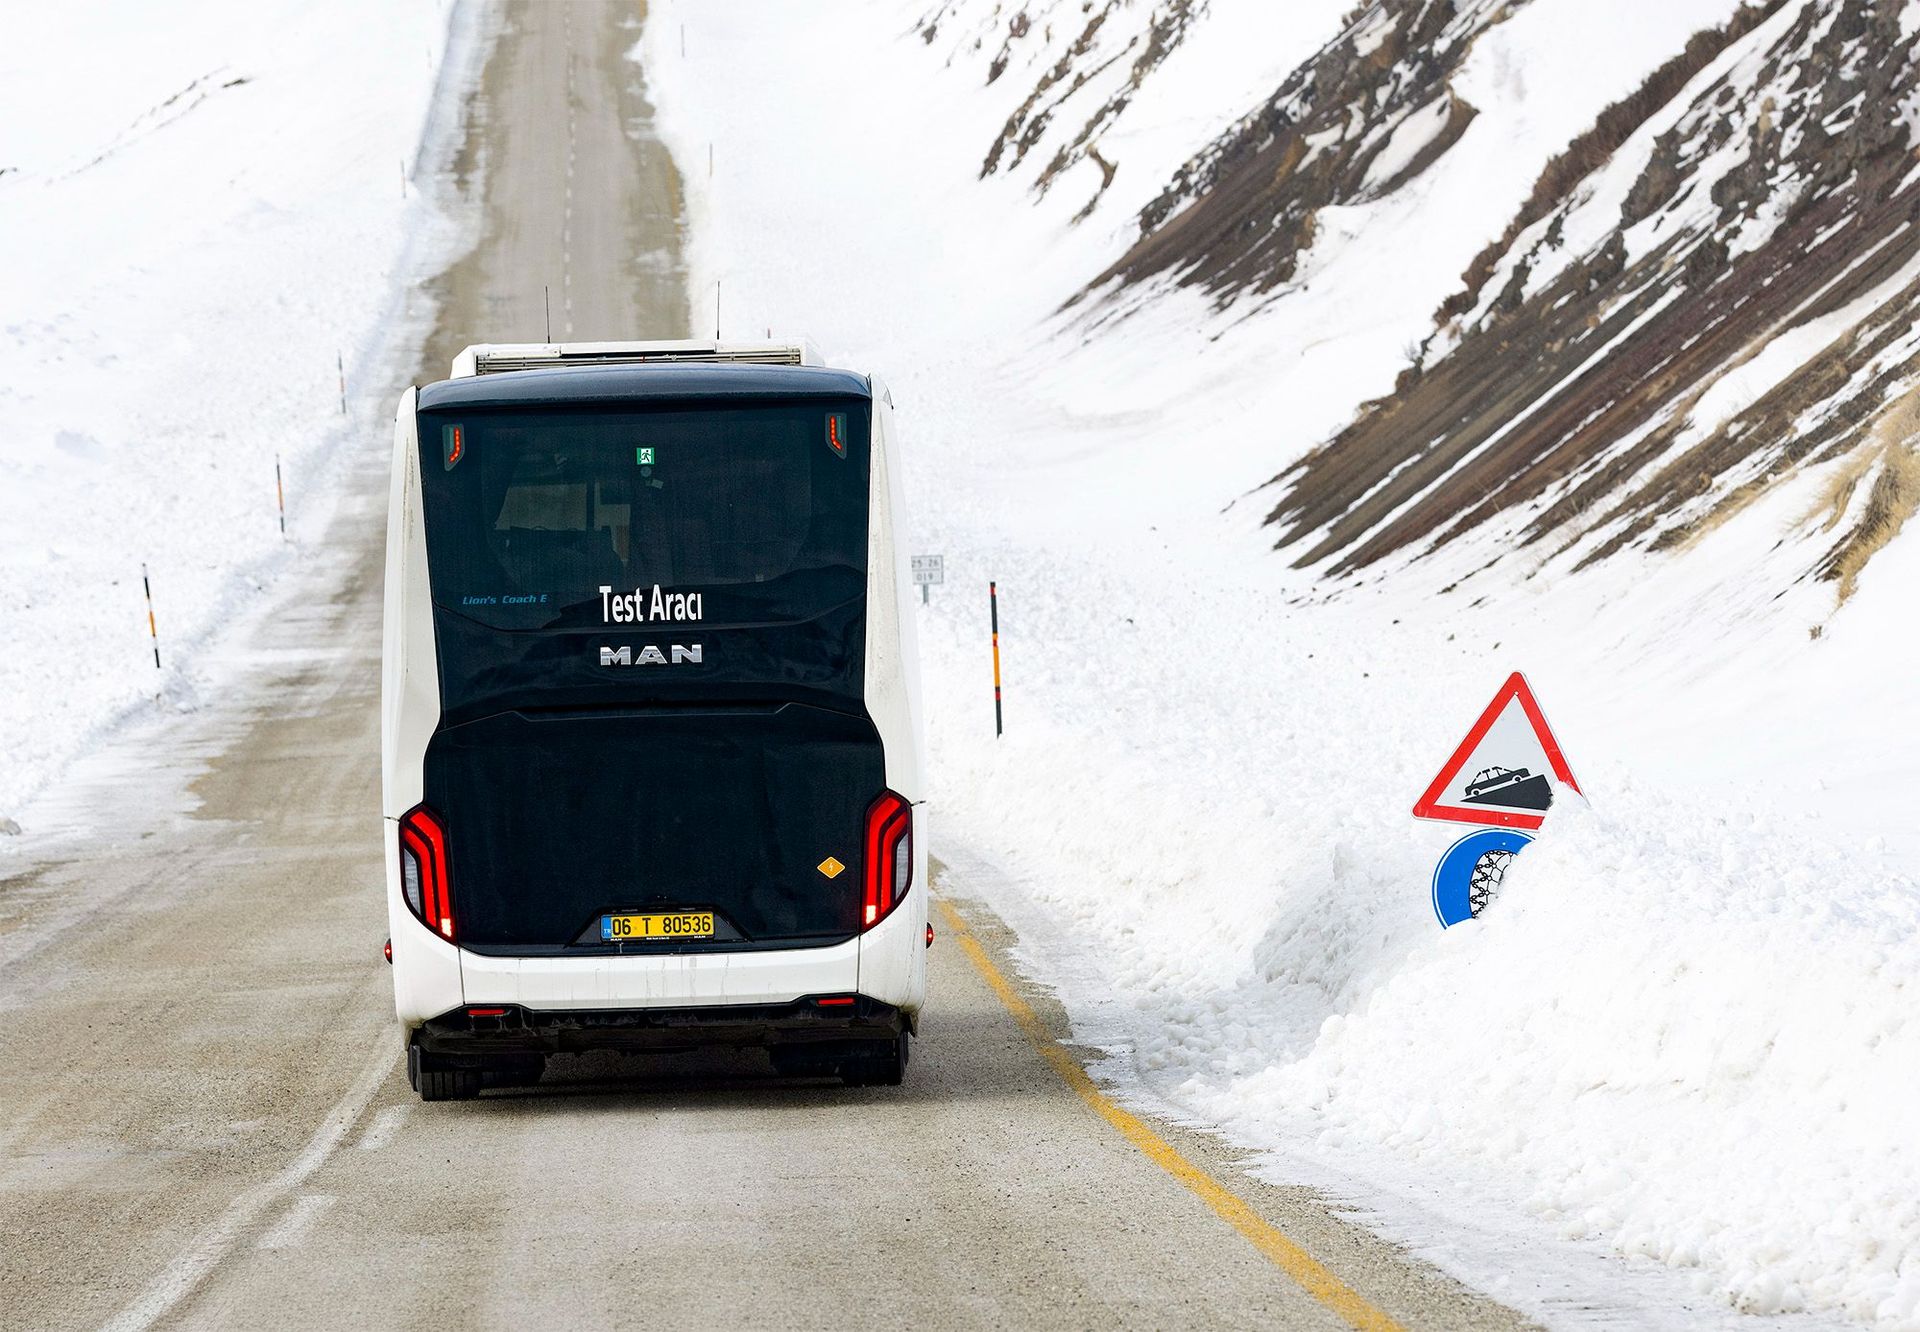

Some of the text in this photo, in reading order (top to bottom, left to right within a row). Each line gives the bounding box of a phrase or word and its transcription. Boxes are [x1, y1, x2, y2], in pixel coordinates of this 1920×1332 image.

[462, 594, 548, 605] Lion's Coach E
[599, 584, 702, 623] Test Aracı
[600, 644, 703, 666] MAN
[612, 915, 711, 936] 06 T 80536
